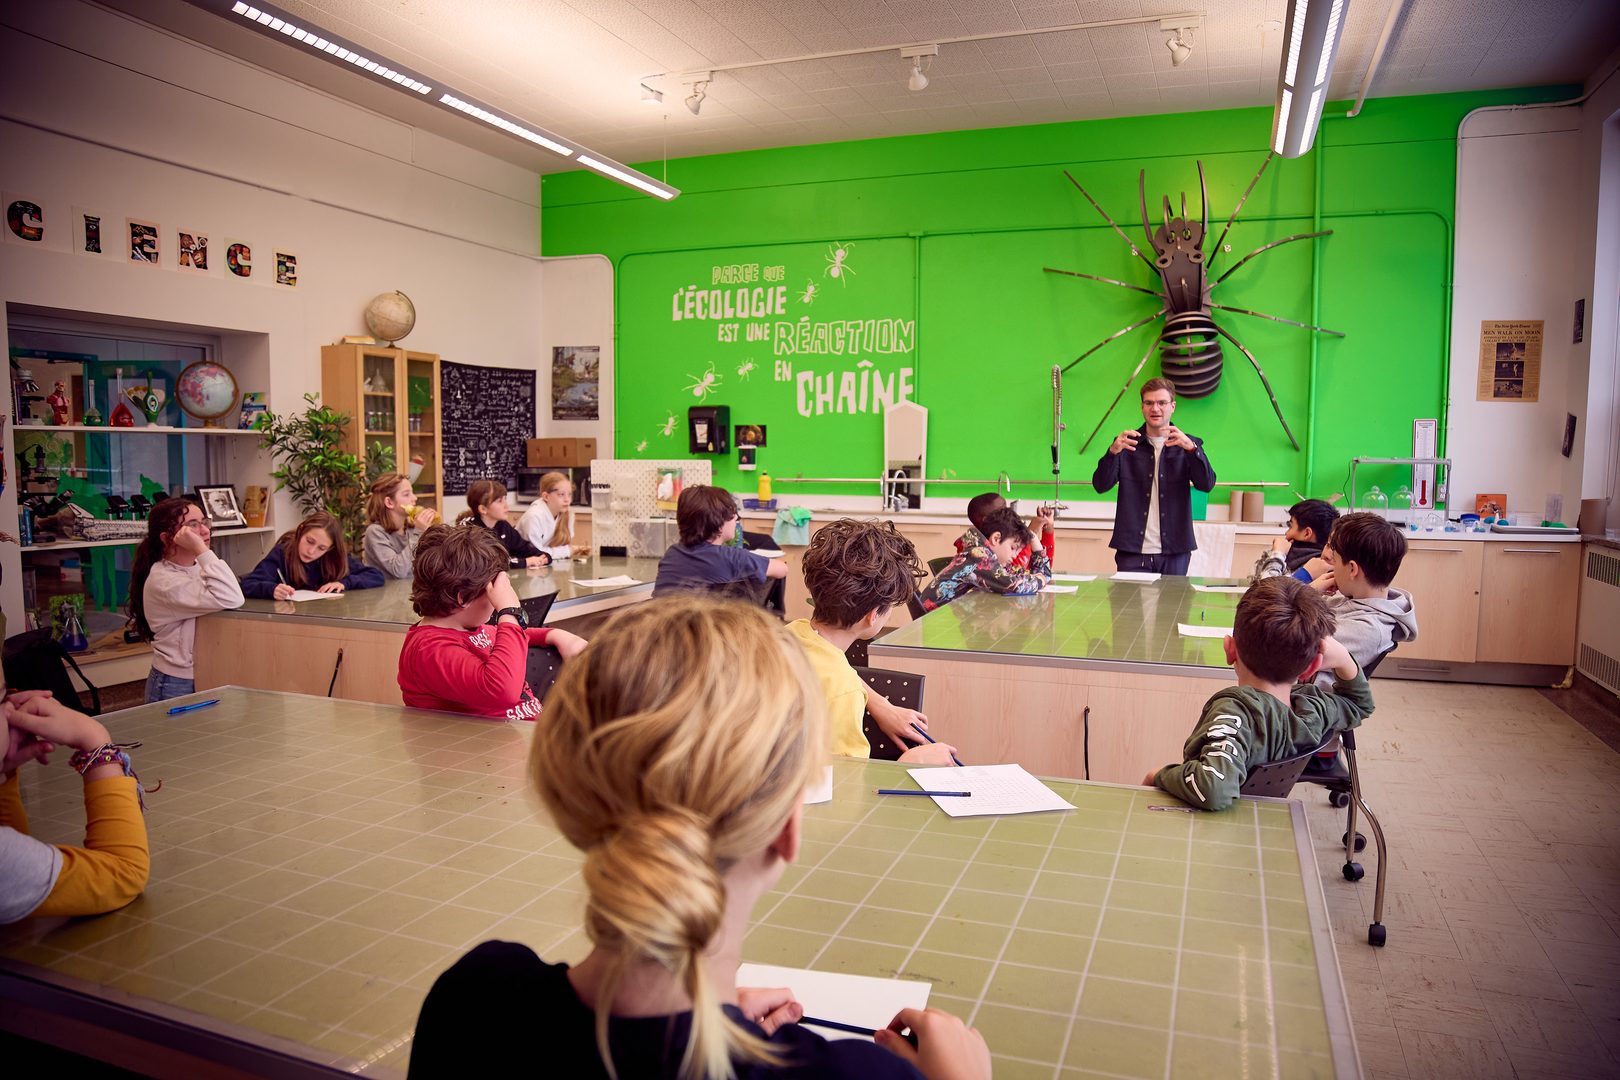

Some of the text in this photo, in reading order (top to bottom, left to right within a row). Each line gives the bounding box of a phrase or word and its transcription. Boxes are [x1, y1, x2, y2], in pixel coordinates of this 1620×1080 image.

[712, 263, 785, 285] PARCE QUE
[672, 285, 787, 321] L'ÉCOLOGIE
[718, 315, 915, 355] EST UNE RÉACTION
[774, 360, 792, 381] EN
[796, 359, 914, 417] CHAÎNE
